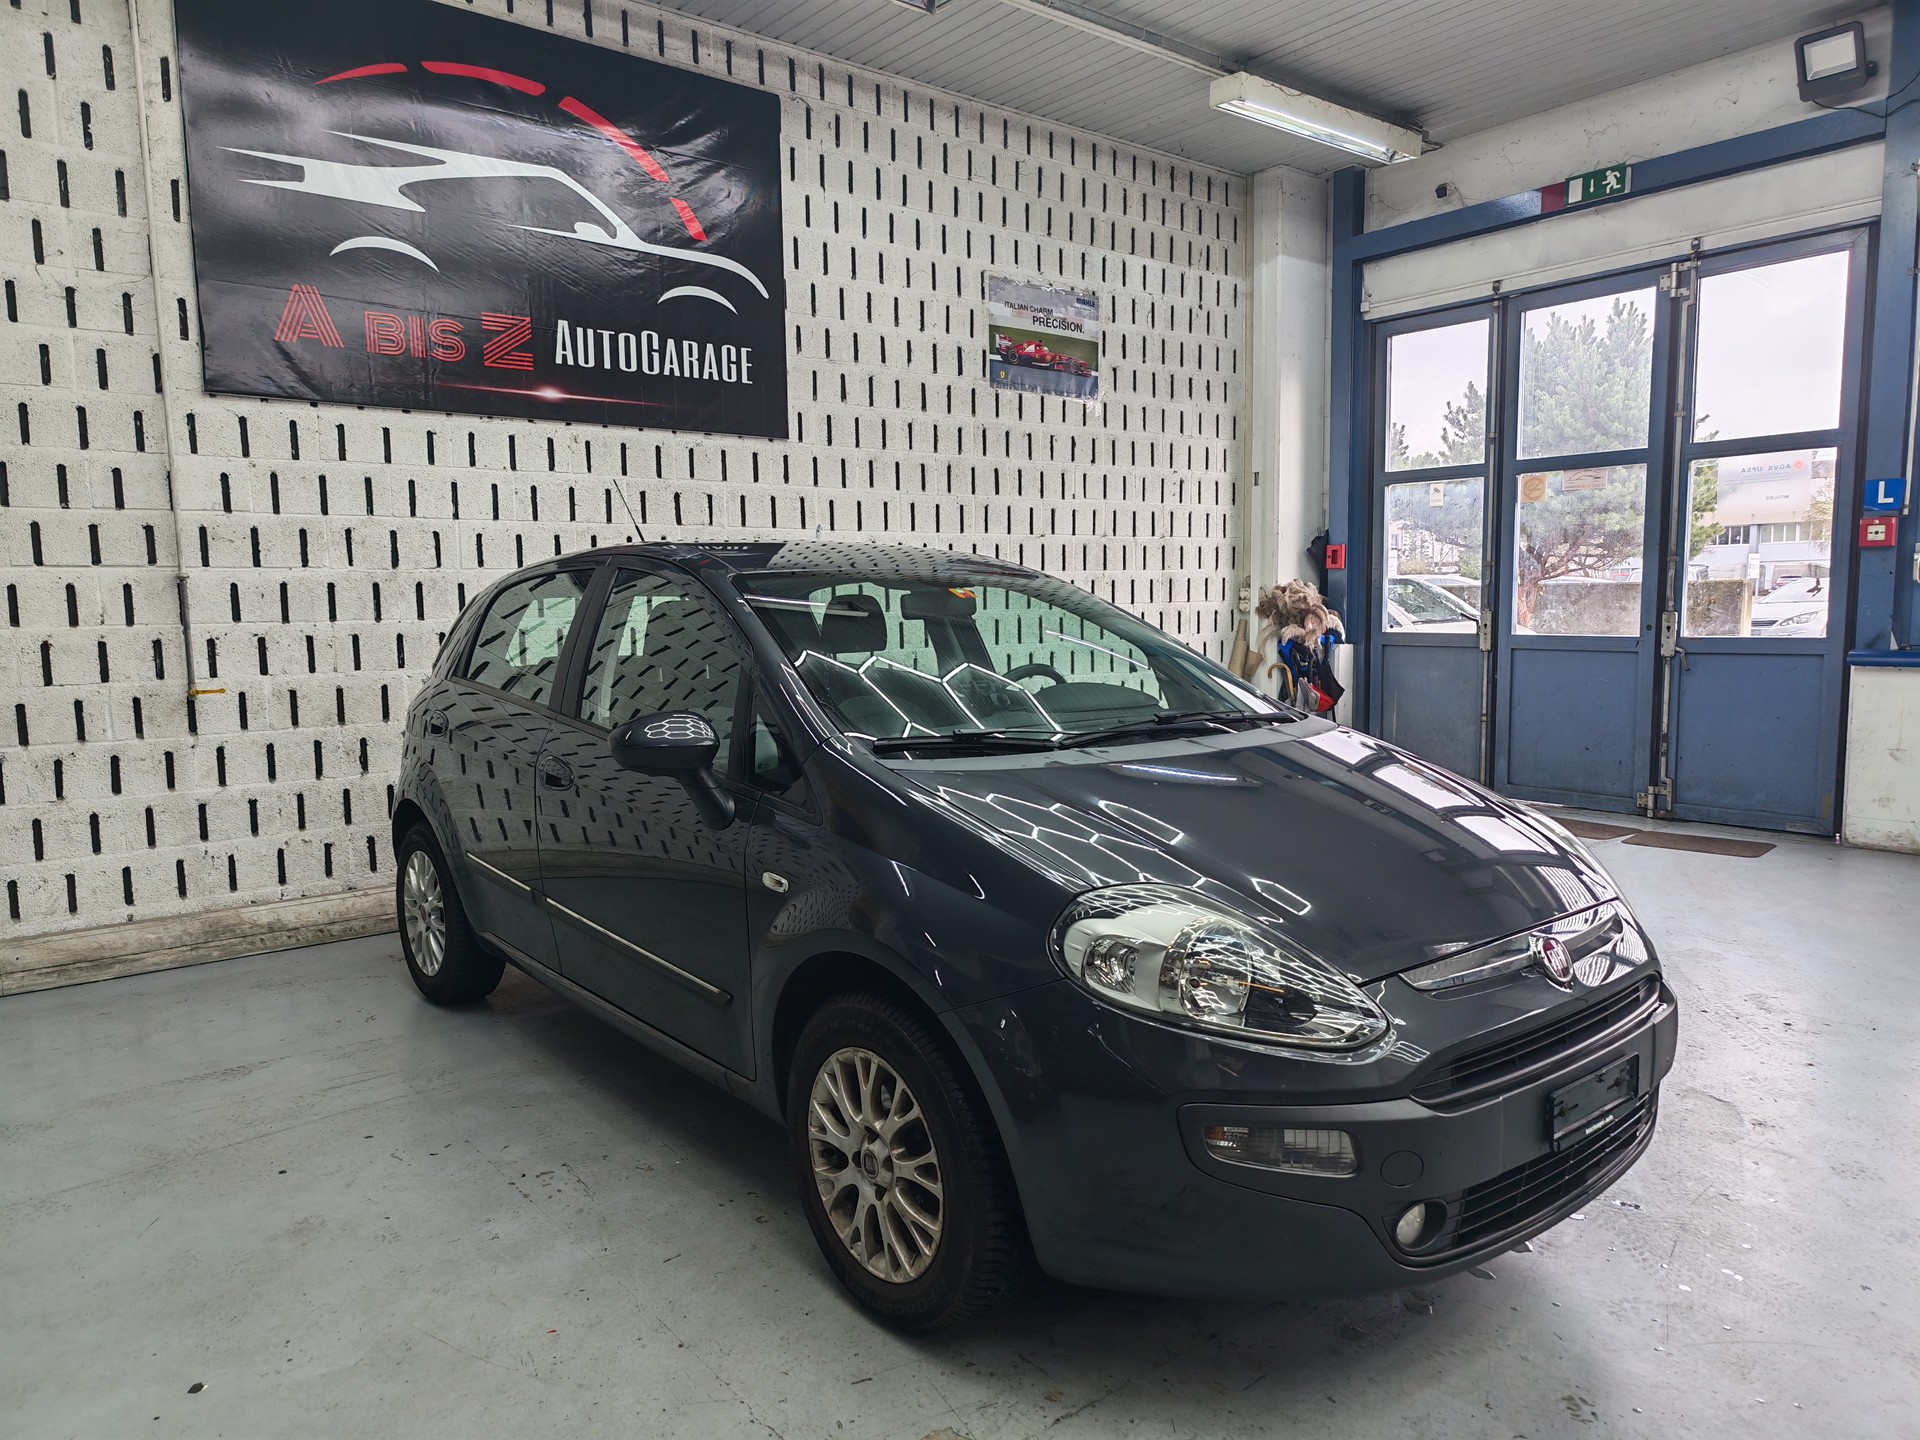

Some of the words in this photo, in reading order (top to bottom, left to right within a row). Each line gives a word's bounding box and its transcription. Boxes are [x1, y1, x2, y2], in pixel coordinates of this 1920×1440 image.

[1004, 301, 1028, 311] ITALIAN
[1029, 305, 1054, 315] CHARM
[274, 283, 344, 349] A
[481, 311, 534, 371] Z
[1032, 315, 1084, 333] PRECISION.
[1878, 481, 1893, 503] L
